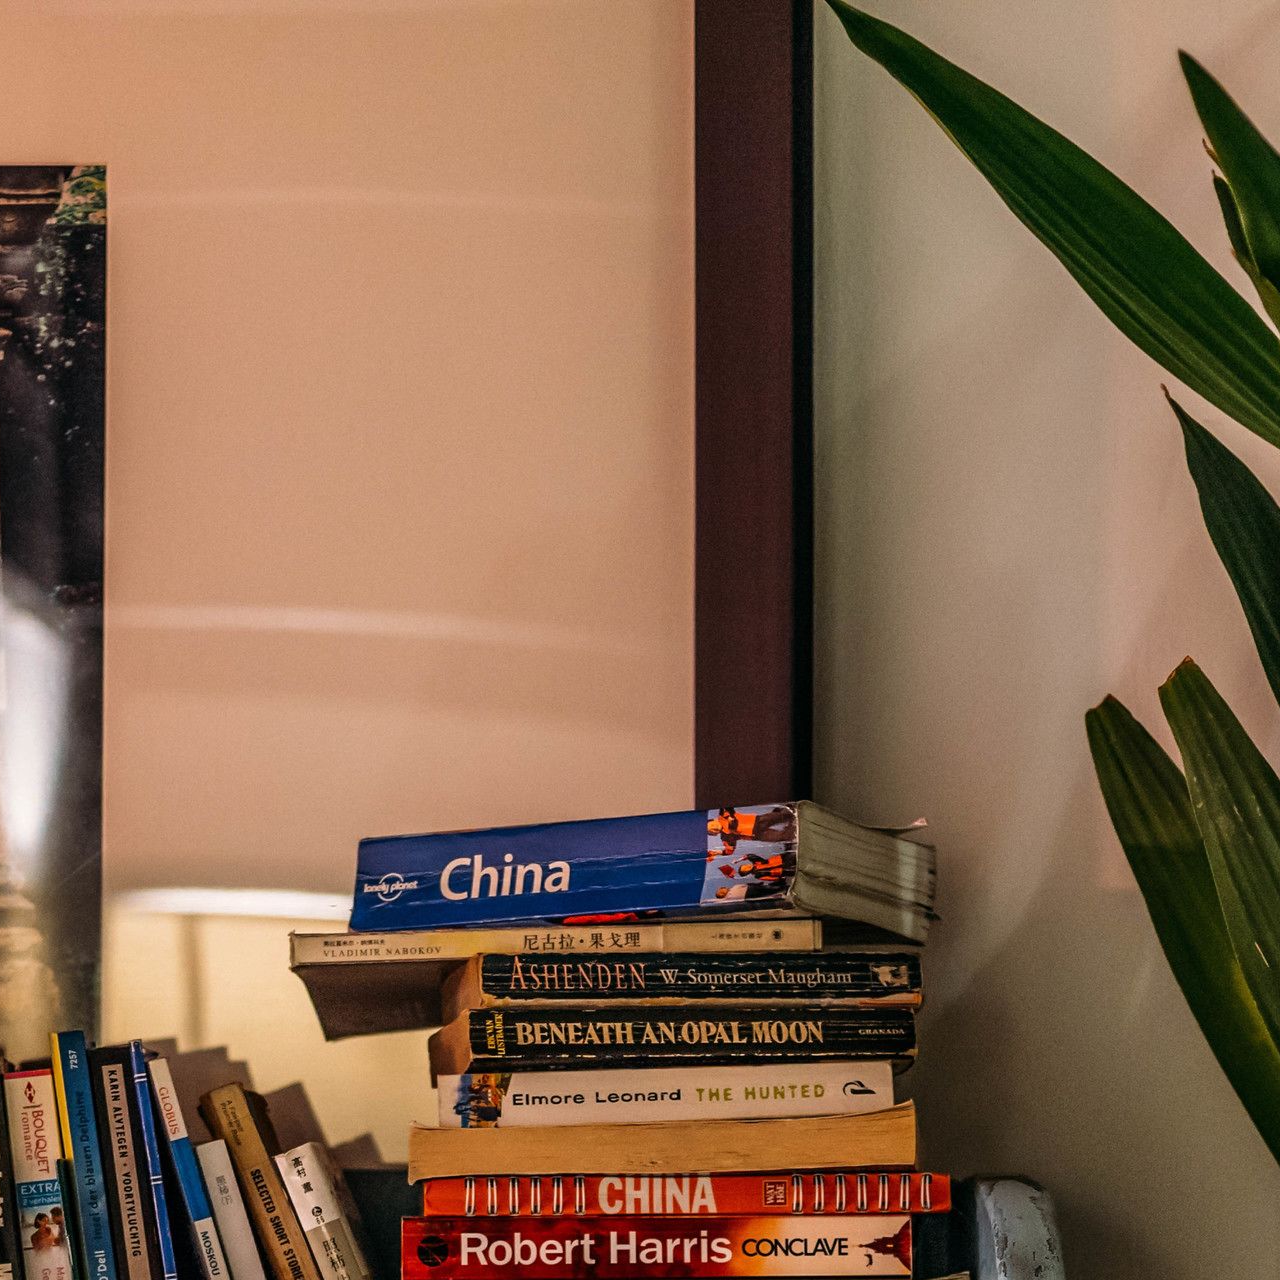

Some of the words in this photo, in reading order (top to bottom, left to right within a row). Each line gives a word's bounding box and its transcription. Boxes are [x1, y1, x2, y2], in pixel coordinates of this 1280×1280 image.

[439, 852, 571, 900] China
[522, 932, 642, 952] 尼古拉·果戈理
[509, 956, 646, 991] ASHENDEN
[660, 968, 681, 984] W.
[687, 968, 759, 984] Somerset
[763, 968, 852, 989] Maugham
[515, 1020, 635, 1046] BENEATH
[641, 1020, 676, 1044] AN
[680, 1020, 747, 1044] OPAL
[751, 1020, 824, 1044] MOON
[512, 1090, 585, 1106] Elmore
[595, 1087, 682, 1104] Leonard
[695, 1086, 732, 1102] THE
[742, 1083, 825, 1101] HUNTED
[597, 1176, 718, 1216] CHINA
[460, 1231, 596, 1267] Robert
[609, 1230, 733, 1264] Harris
[742, 1237, 849, 1258] CONCLAVE
